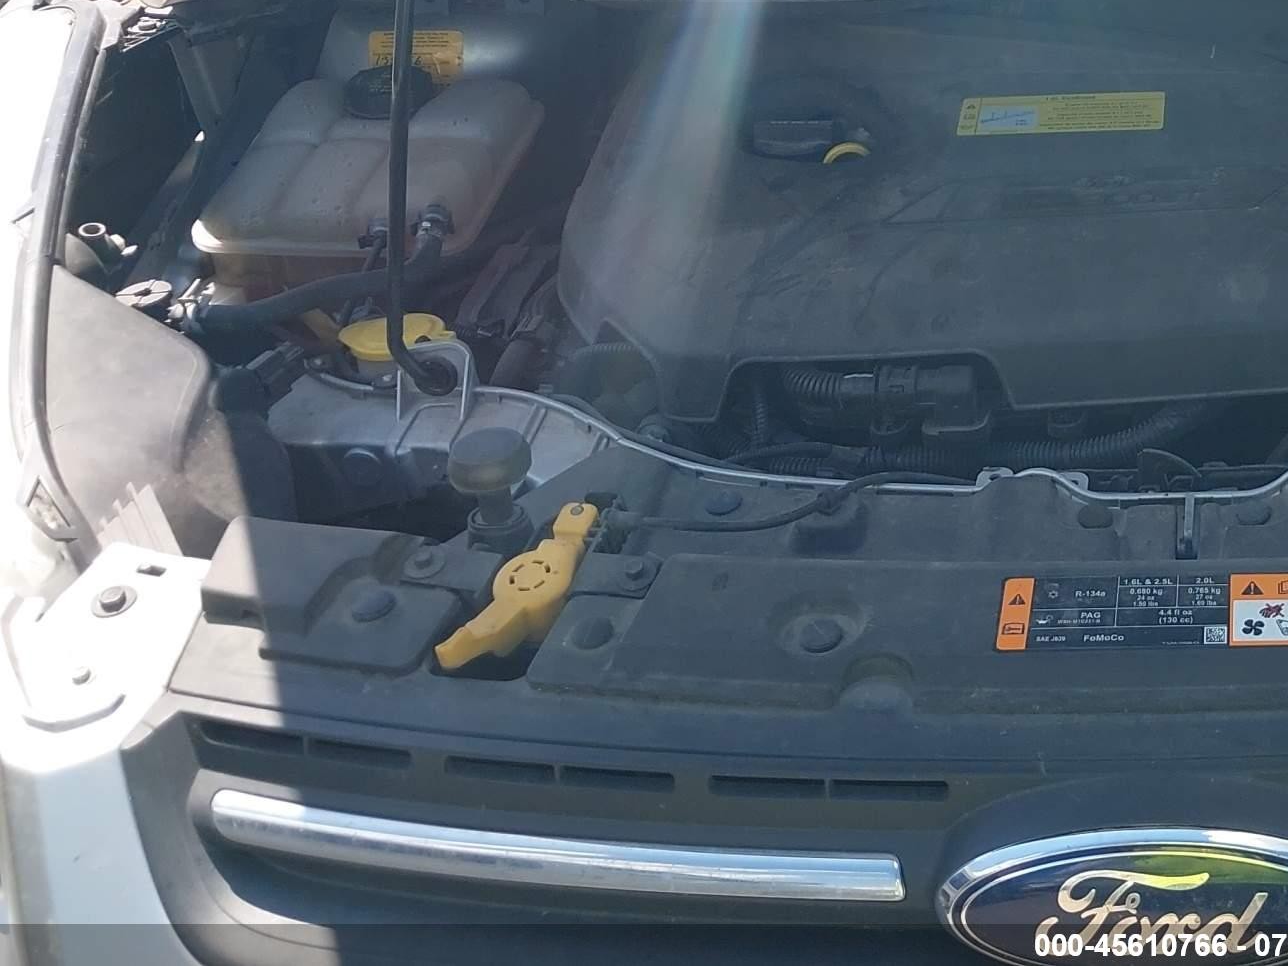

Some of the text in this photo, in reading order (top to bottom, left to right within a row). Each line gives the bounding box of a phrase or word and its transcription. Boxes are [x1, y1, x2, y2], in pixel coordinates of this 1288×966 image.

[1152, 588, 1163, 596] kg
[1211, 587, 1221, 595] kg
[1158, 616, 1194, 624] (130 cc)
[1083, 634, 1125, 642] FoMoCo
[1035, 869, 1269, 956] Ford
